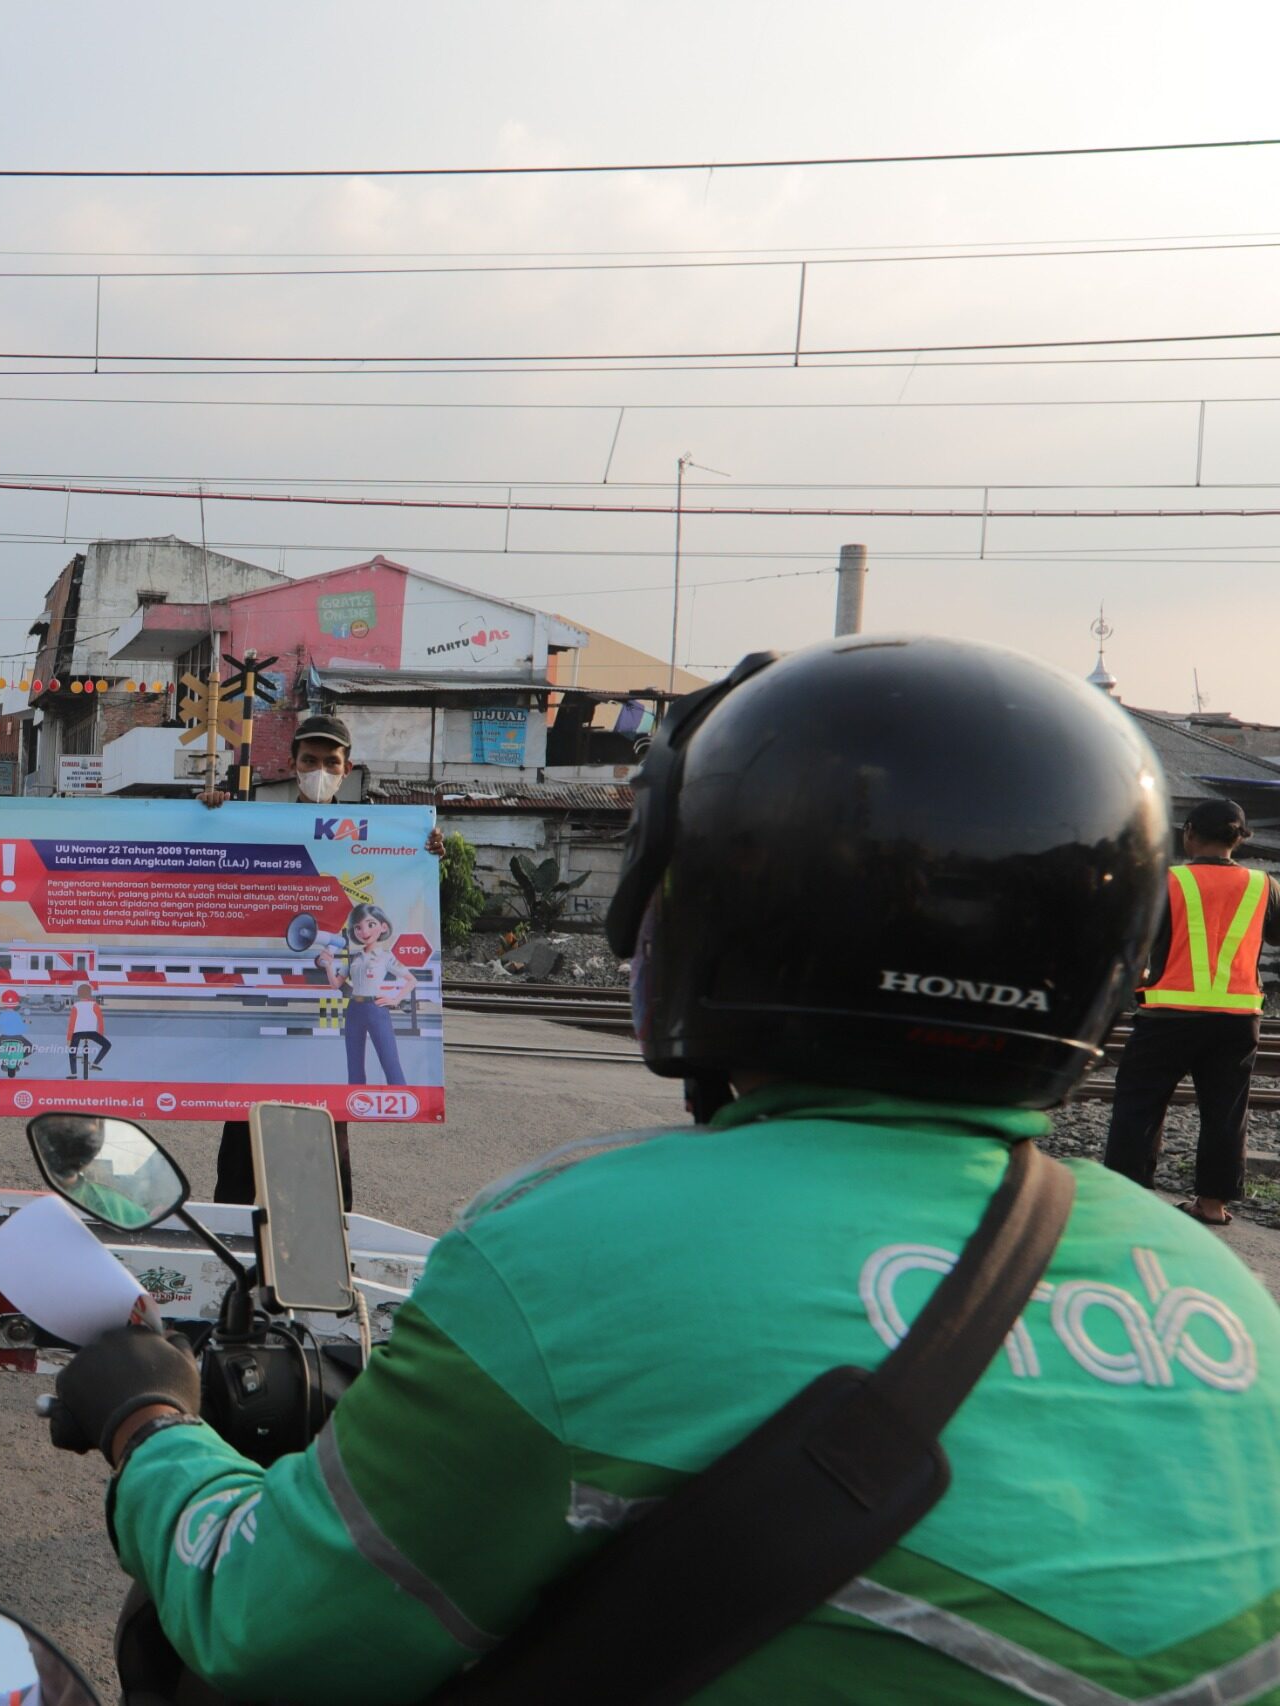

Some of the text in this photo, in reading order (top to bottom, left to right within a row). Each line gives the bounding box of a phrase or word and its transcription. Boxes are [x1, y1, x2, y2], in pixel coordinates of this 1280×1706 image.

[473, 710, 526, 721] DIJUAL
[314, 818, 368, 840] KAI
[55, 845, 227, 858] UU Nomor 22 Tahun 2009 Tentang
[351, 844, 418, 856] Commuter
[55, 856, 302, 870] Lalu Lintas dan Angkutan Jalan (LLAJ) Pasal 296
[47, 880, 100, 889] Pengendara
[102, 880, 148, 888] kendaraan
[151, 881, 191, 889] bermotor
[193, 883, 215, 892] yang
[240, 883, 276, 891] berhenti
[278, 884, 303, 892] ketika
[305, 885, 330, 894] sinyal
[47, 888, 74, 897] sudah
[118, 890, 148, 900] palang
[151, 891, 173, 899] pintu
[188, 891, 215, 899] sudah
[217, 892, 242, 900] mulai
[278, 893, 319, 902] dan/atau
[96, 899, 118, 907] akan
[120, 899, 158, 909] dipidana
[160, 901, 194, 910] dengan
[196, 901, 227, 910] pidana
[228, 903, 270, 911] kurungan
[272, 904, 298, 912] paling
[47, 907, 53, 915] 3
[54, 908, 79, 916] bulan
[81, 908, 101, 916] atau
[103, 909, 134, 917] denda
[135, 909, 160, 919] paling
[162, 910, 194, 920] banyak
[47, 916, 74, 926] (Tujuh
[76, 917, 100, 925] Ratus
[102, 917, 124, 925] Lima
[125, 918, 149, 926] Puluh
[151, 918, 170, 927] Ribu
[398, 946, 426, 954] STOP
[879, 970, 1049, 1012] HONDA
[38, 1095, 144, 1107] commuterline.id
[376, 1095, 409, 1114] 121
